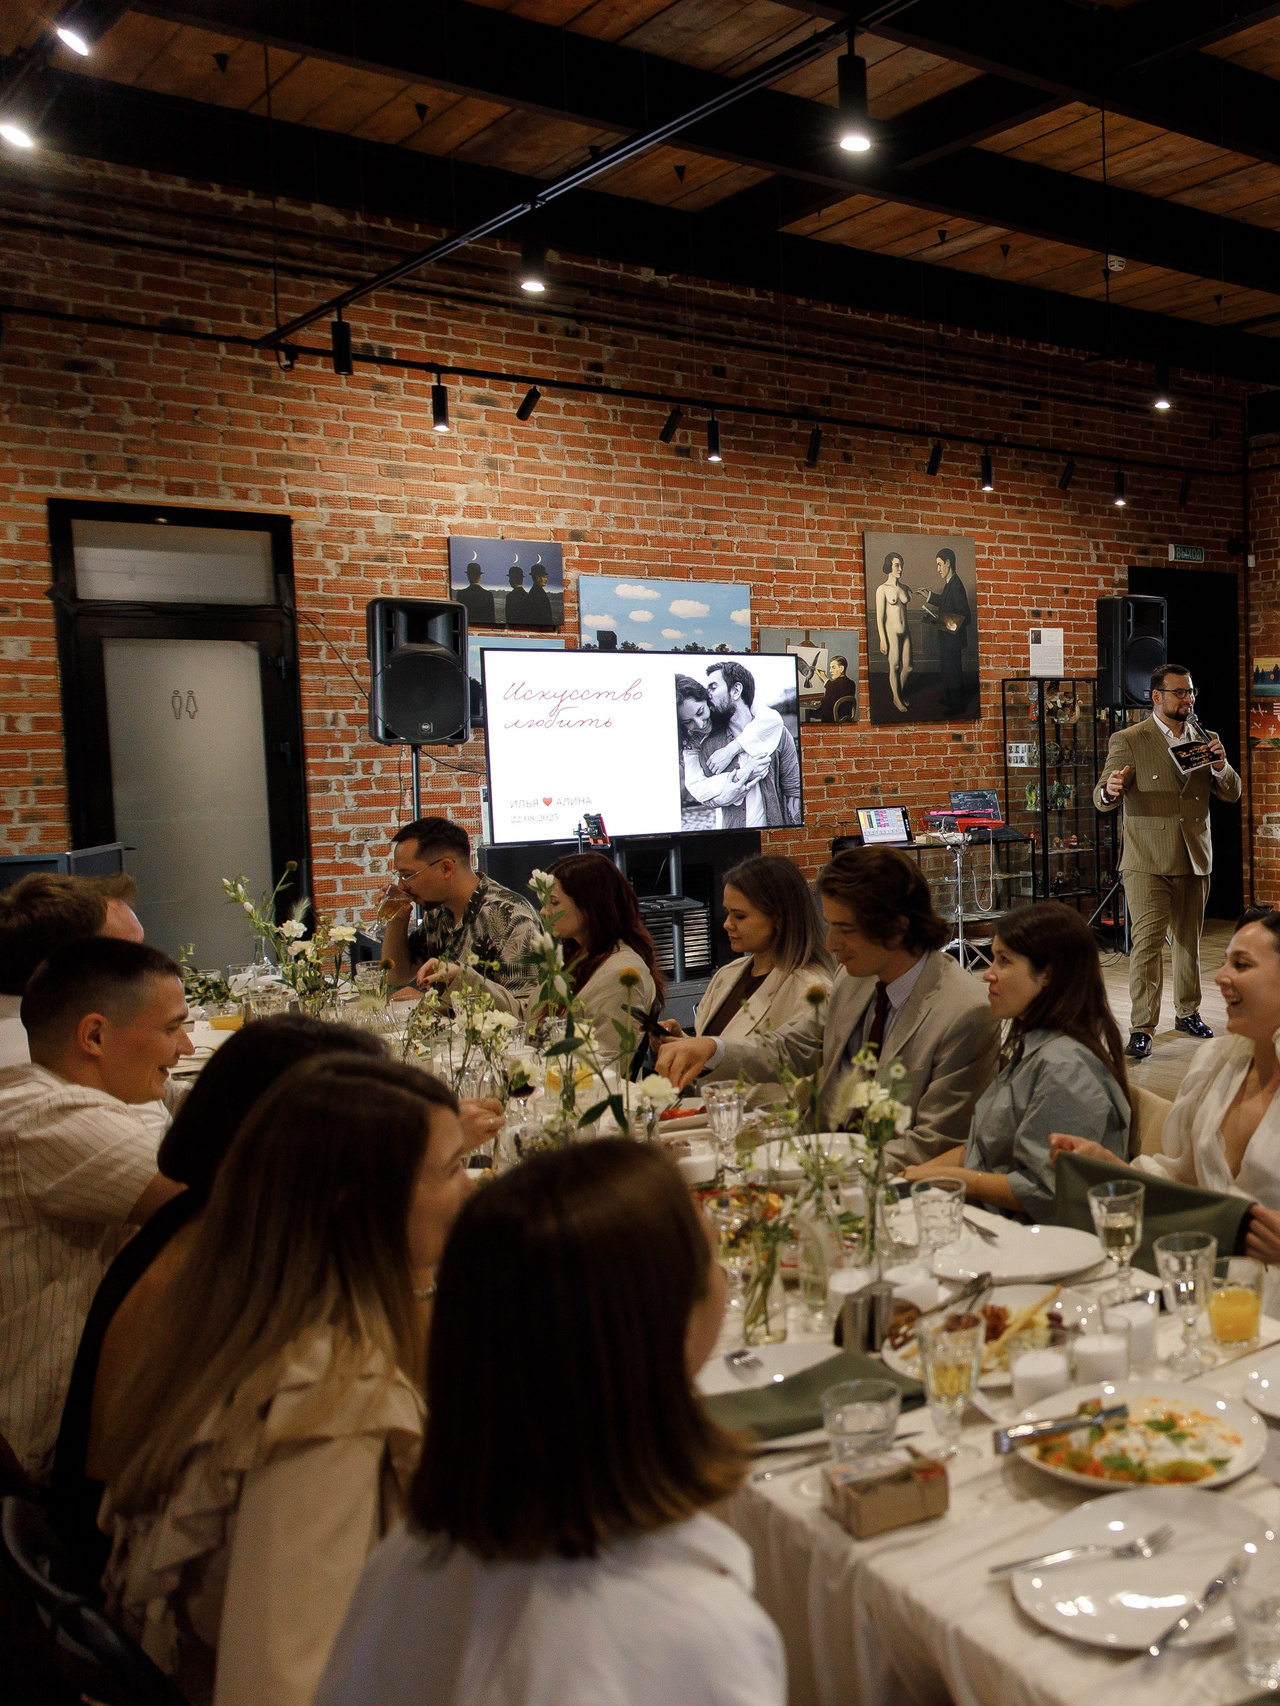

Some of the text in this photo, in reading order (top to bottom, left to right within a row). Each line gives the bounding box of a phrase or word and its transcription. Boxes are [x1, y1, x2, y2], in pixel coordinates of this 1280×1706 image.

[1176, 547, 1202, 561] ВЫХОД
[503, 678, 643, 717] Искусство
[504, 706, 612, 728] любить
[510, 797, 592, 809] ИЛЬЯ АЛИНА
[511, 813, 559, 824] 22.08.2025
